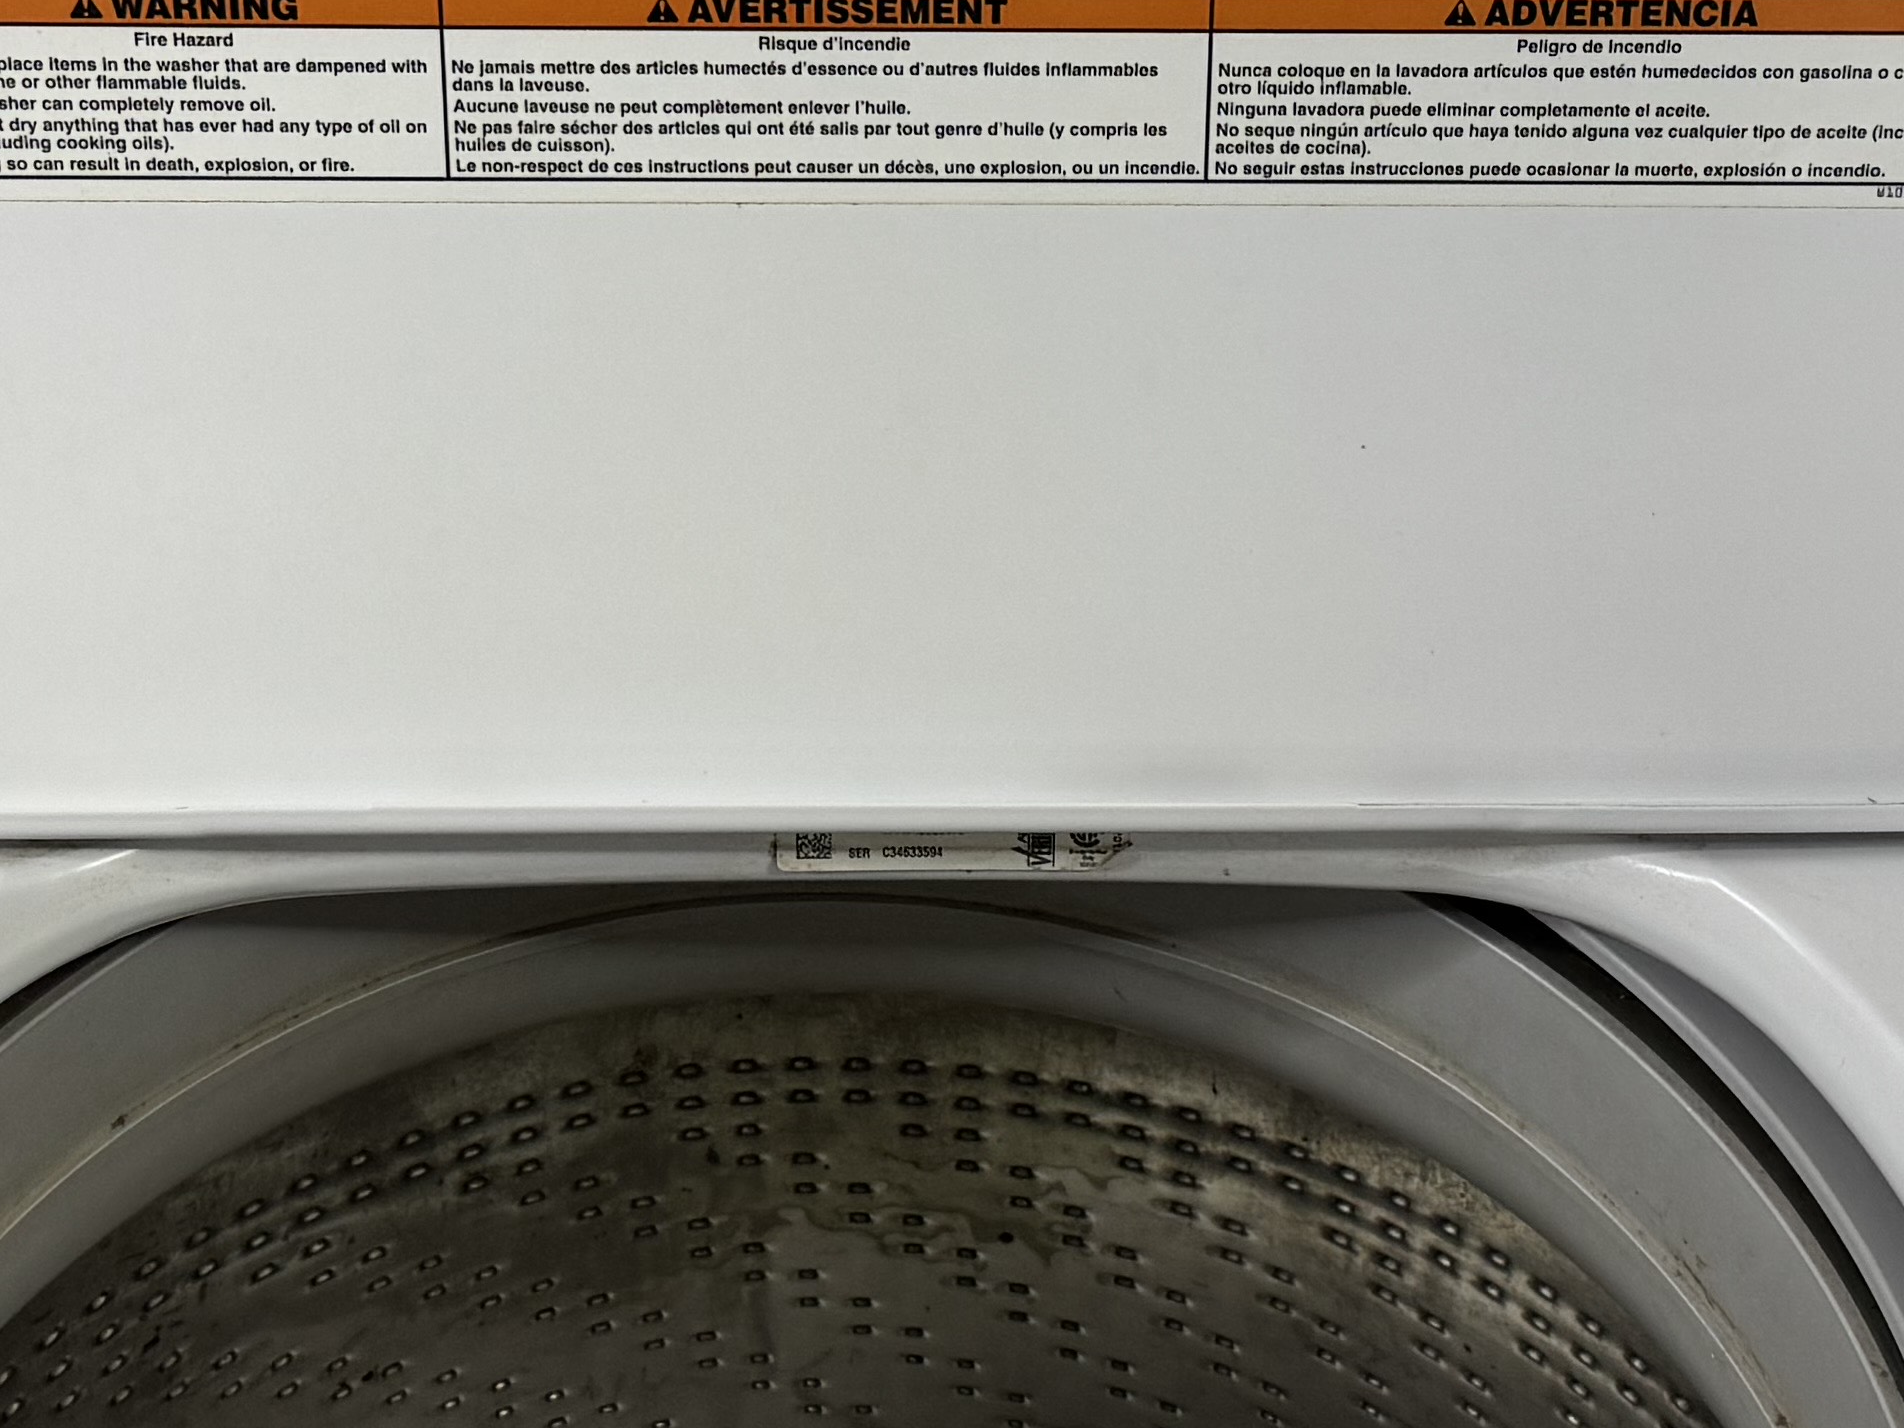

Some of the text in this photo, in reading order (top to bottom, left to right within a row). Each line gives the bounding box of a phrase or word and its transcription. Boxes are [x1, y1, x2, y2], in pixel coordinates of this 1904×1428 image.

[1485, 0, 1758, 26] ADVERTENCIA
[134, 32, 233, 46] Fire Hazard
[759, 36, 910, 54] Risque d'incendie
[1517, 39, 1682, 56] Peligro de Incendio
[42, 100, 73, 110] can
[79, 97, 174, 114] completely
[180, 100, 244, 111] remove
[250, 98, 275, 111] oil.
[848, 847, 870, 858] SER
